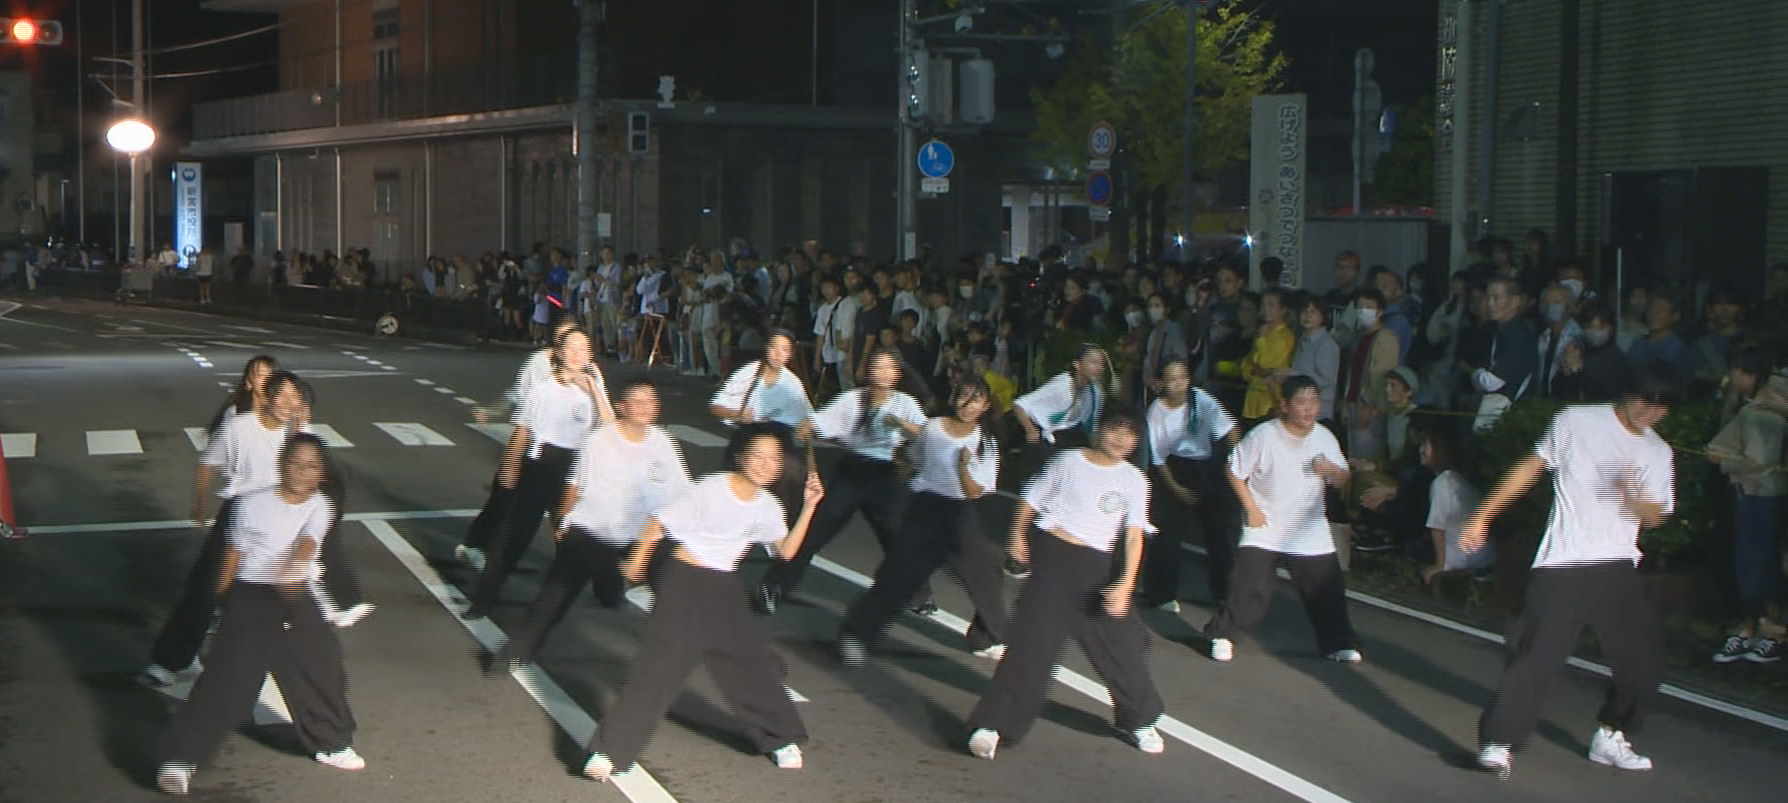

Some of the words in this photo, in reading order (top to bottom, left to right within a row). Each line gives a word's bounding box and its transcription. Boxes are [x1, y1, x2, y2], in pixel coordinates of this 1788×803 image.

[1094, 132, 1108, 149] 30
[1279, 105, 1299, 161] 広げよう
